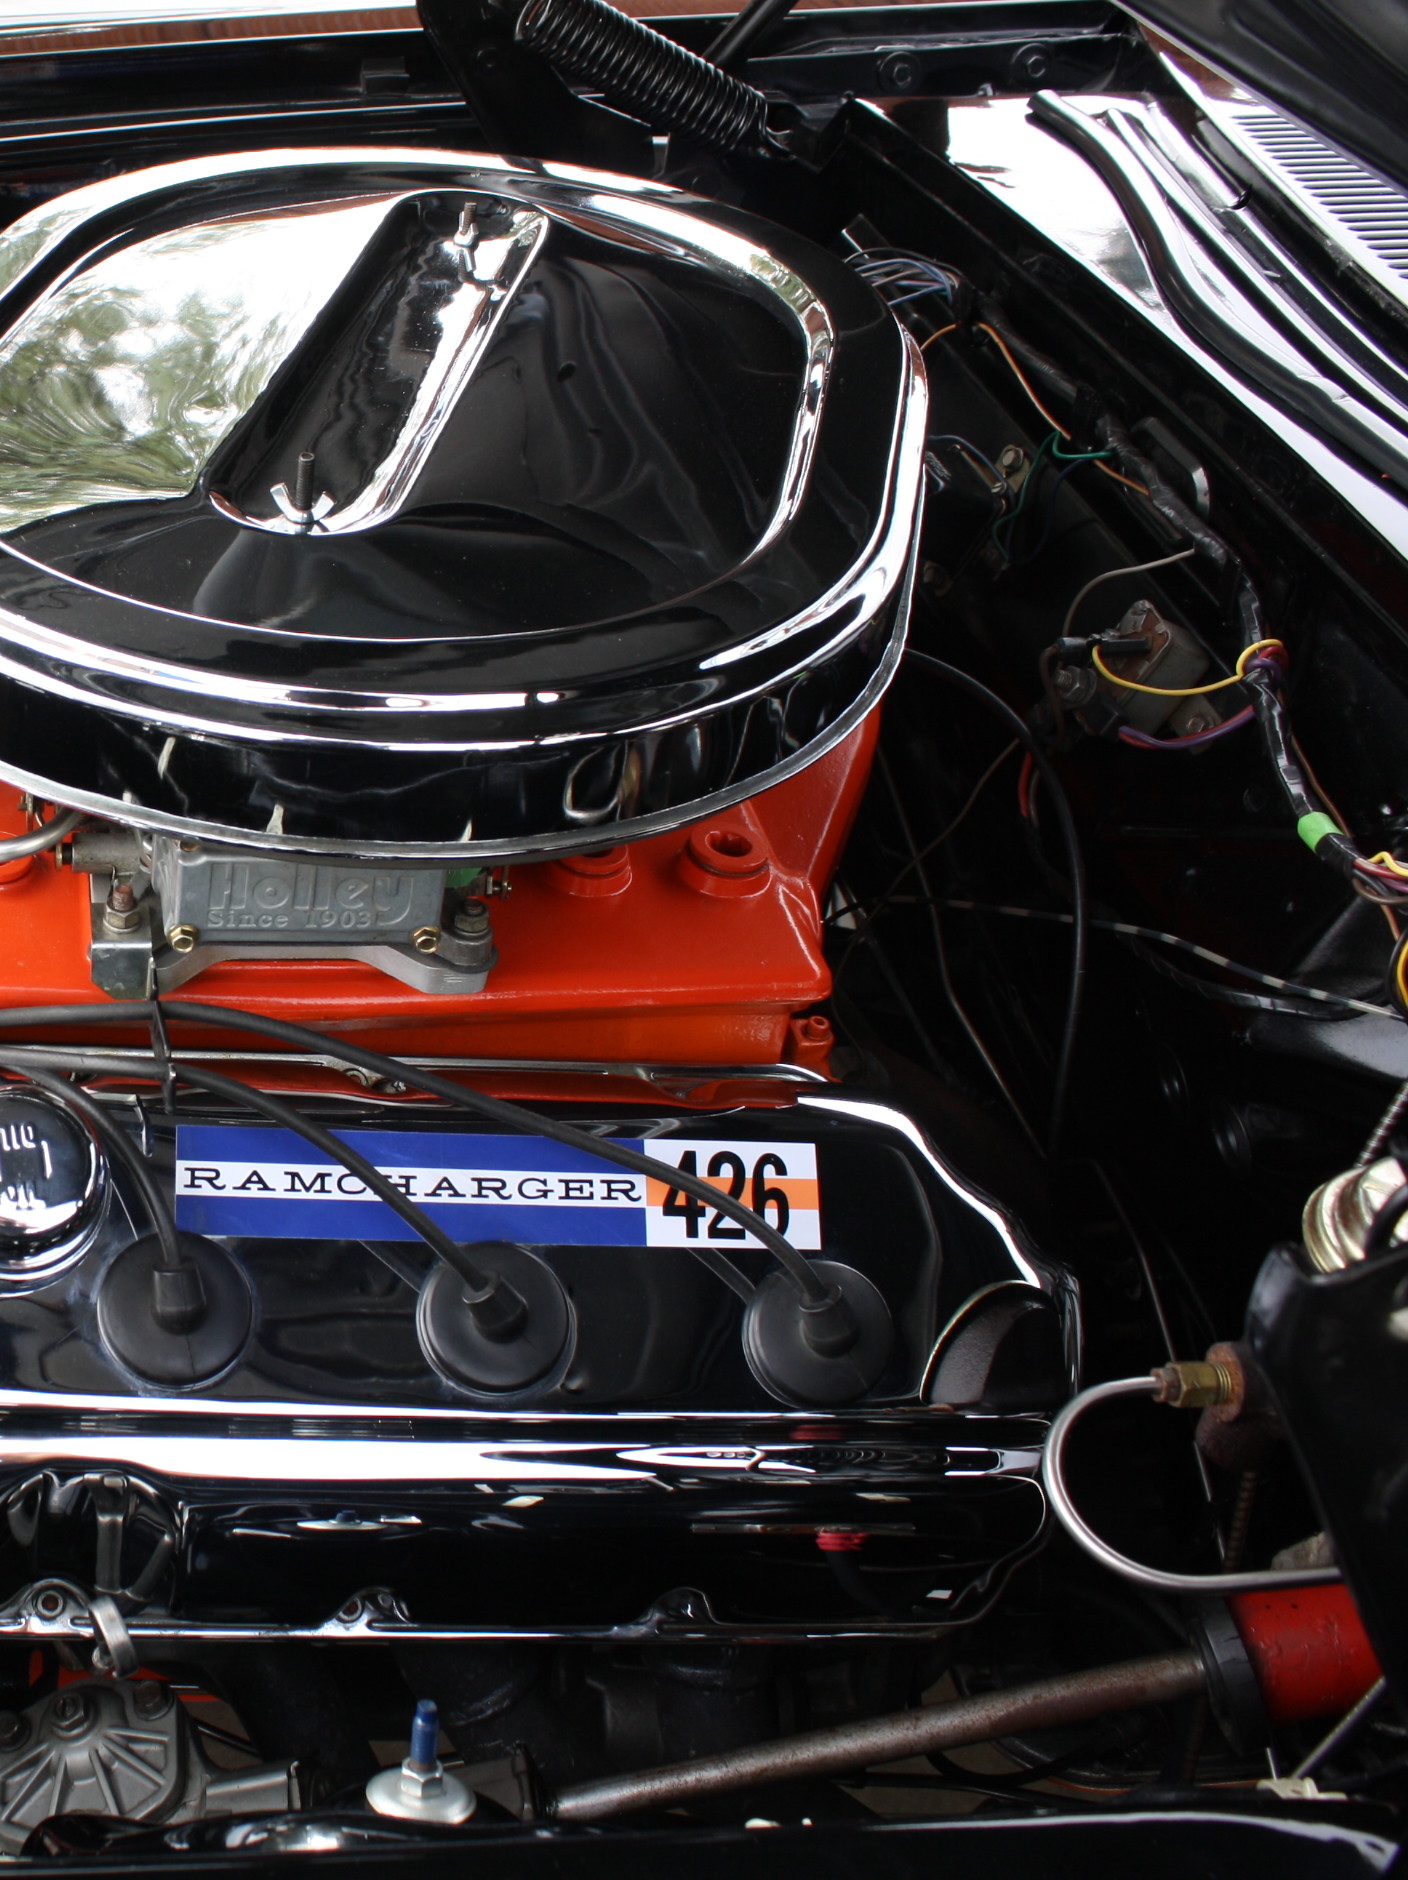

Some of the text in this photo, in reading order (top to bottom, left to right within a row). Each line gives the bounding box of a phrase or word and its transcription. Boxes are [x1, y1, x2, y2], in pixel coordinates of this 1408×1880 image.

[207, 910, 371, 928] Since 1903
[208, 862, 415, 926] Holley
[183, 1150, 790, 1240] RAMCHARGER 426
